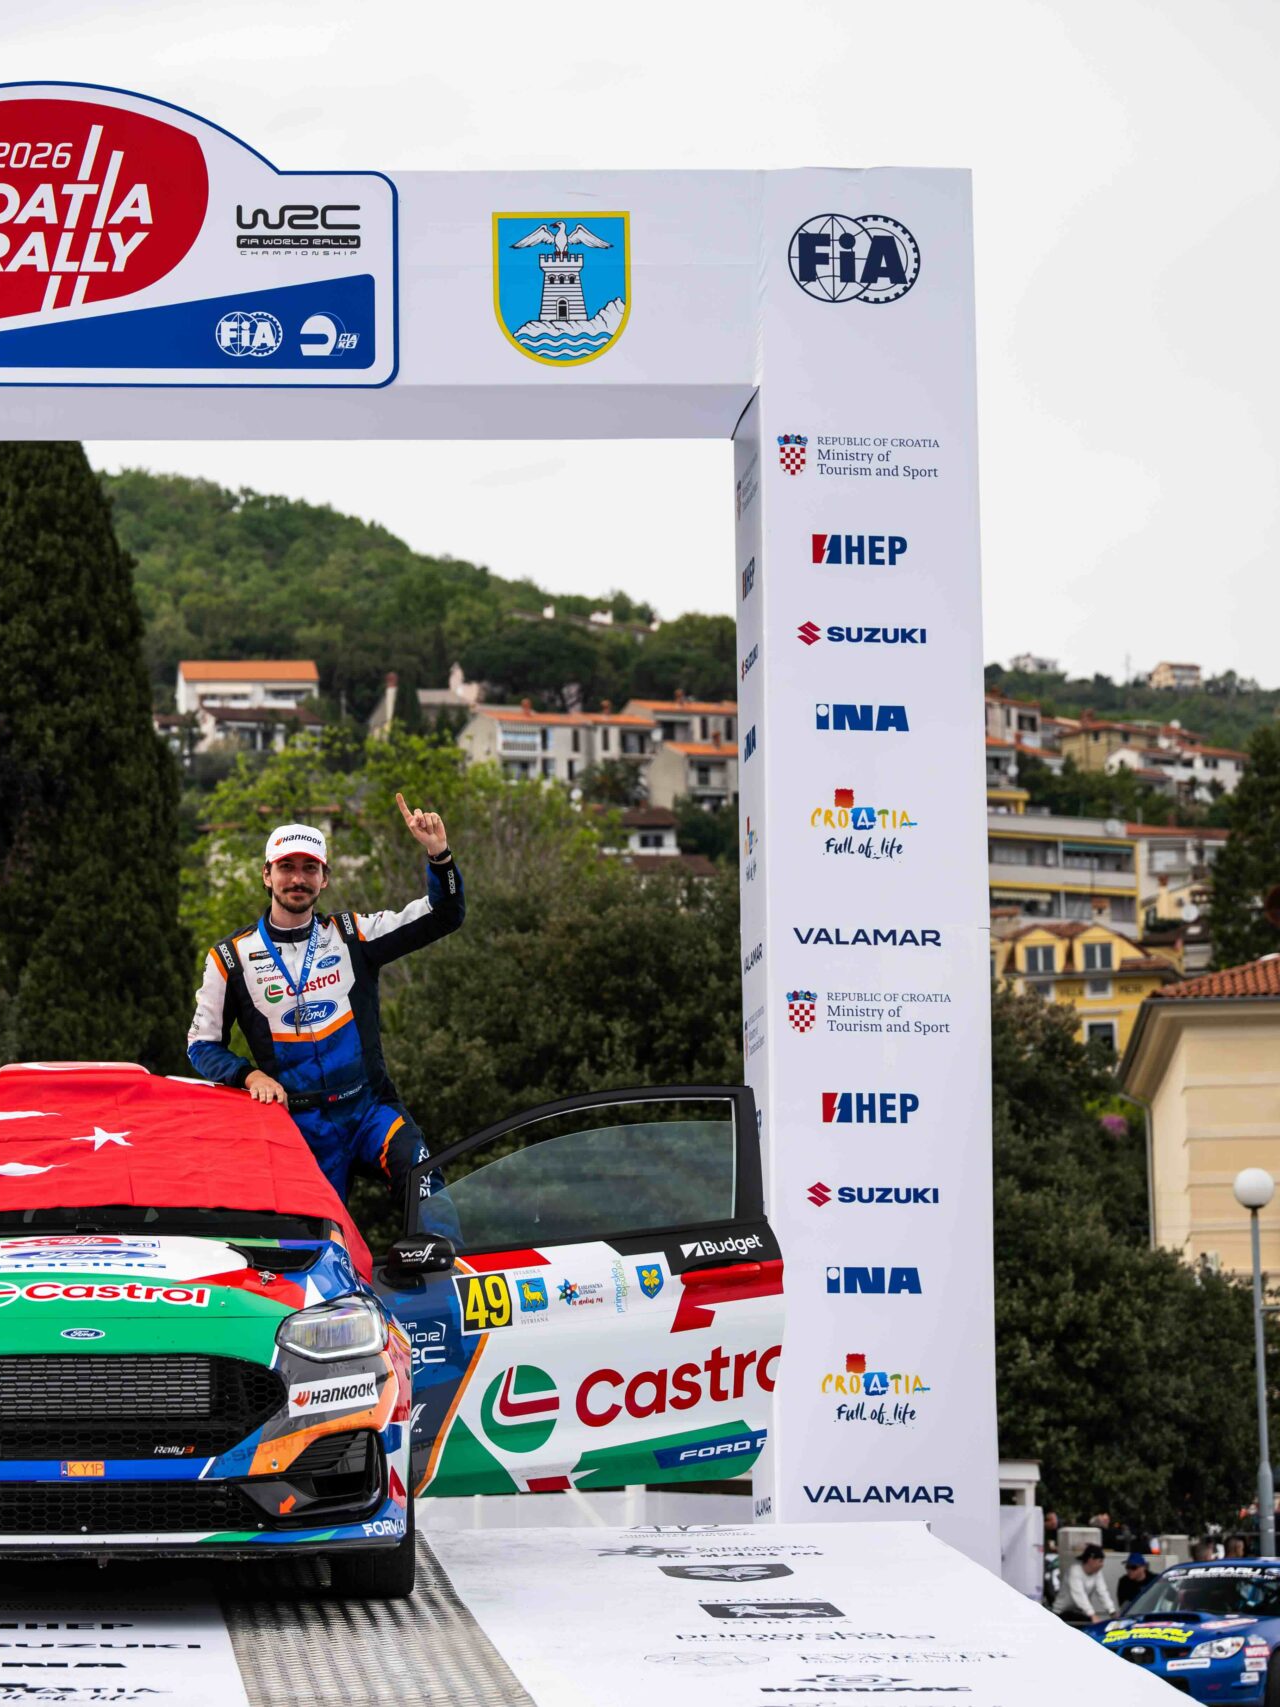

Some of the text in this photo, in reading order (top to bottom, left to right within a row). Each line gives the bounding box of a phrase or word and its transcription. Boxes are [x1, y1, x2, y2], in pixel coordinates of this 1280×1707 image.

[236, 204, 360, 230] WRC
[817, 437, 940, 448] REPUBLIC OF CROATIA
[817, 449, 891, 464] Ministry of
[817, 464, 938, 479] Tourism and Sport
[845, 535, 908, 566] HEP
[827, 626, 926, 644] SUZUKI
[810, 807, 918, 830] CROATIA
[825, 837, 904, 858] Full of life
[794, 927, 941, 946] VALAMAR
[827, 992, 951, 1003] REPUBLIC OF CROATIA
[827, 1005, 901, 1020] Ministry of
[827, 1020, 950, 1035] Tourism and Sport
[855, 1093, 919, 1124] HEP
[837, 1187, 939, 1204] SUZUKI
[701, 1234, 763, 1256] Budget
[25, 1283, 208, 1304] Castrol
[464, 1275, 513, 1329] 49
[575, 1344, 783, 1428] Castro
[821, 1371, 931, 1395] CROATIA
[837, 1403, 917, 1424] Full of life
[154, 1445, 196, 1456] Rally3
[679, 1440, 751, 1461] FORD
[803, 1485, 954, 1504] VALAMAR
[362, 1519, 405, 1537] FORVIA
[1188, 1567, 1262, 1575] SUBARU
